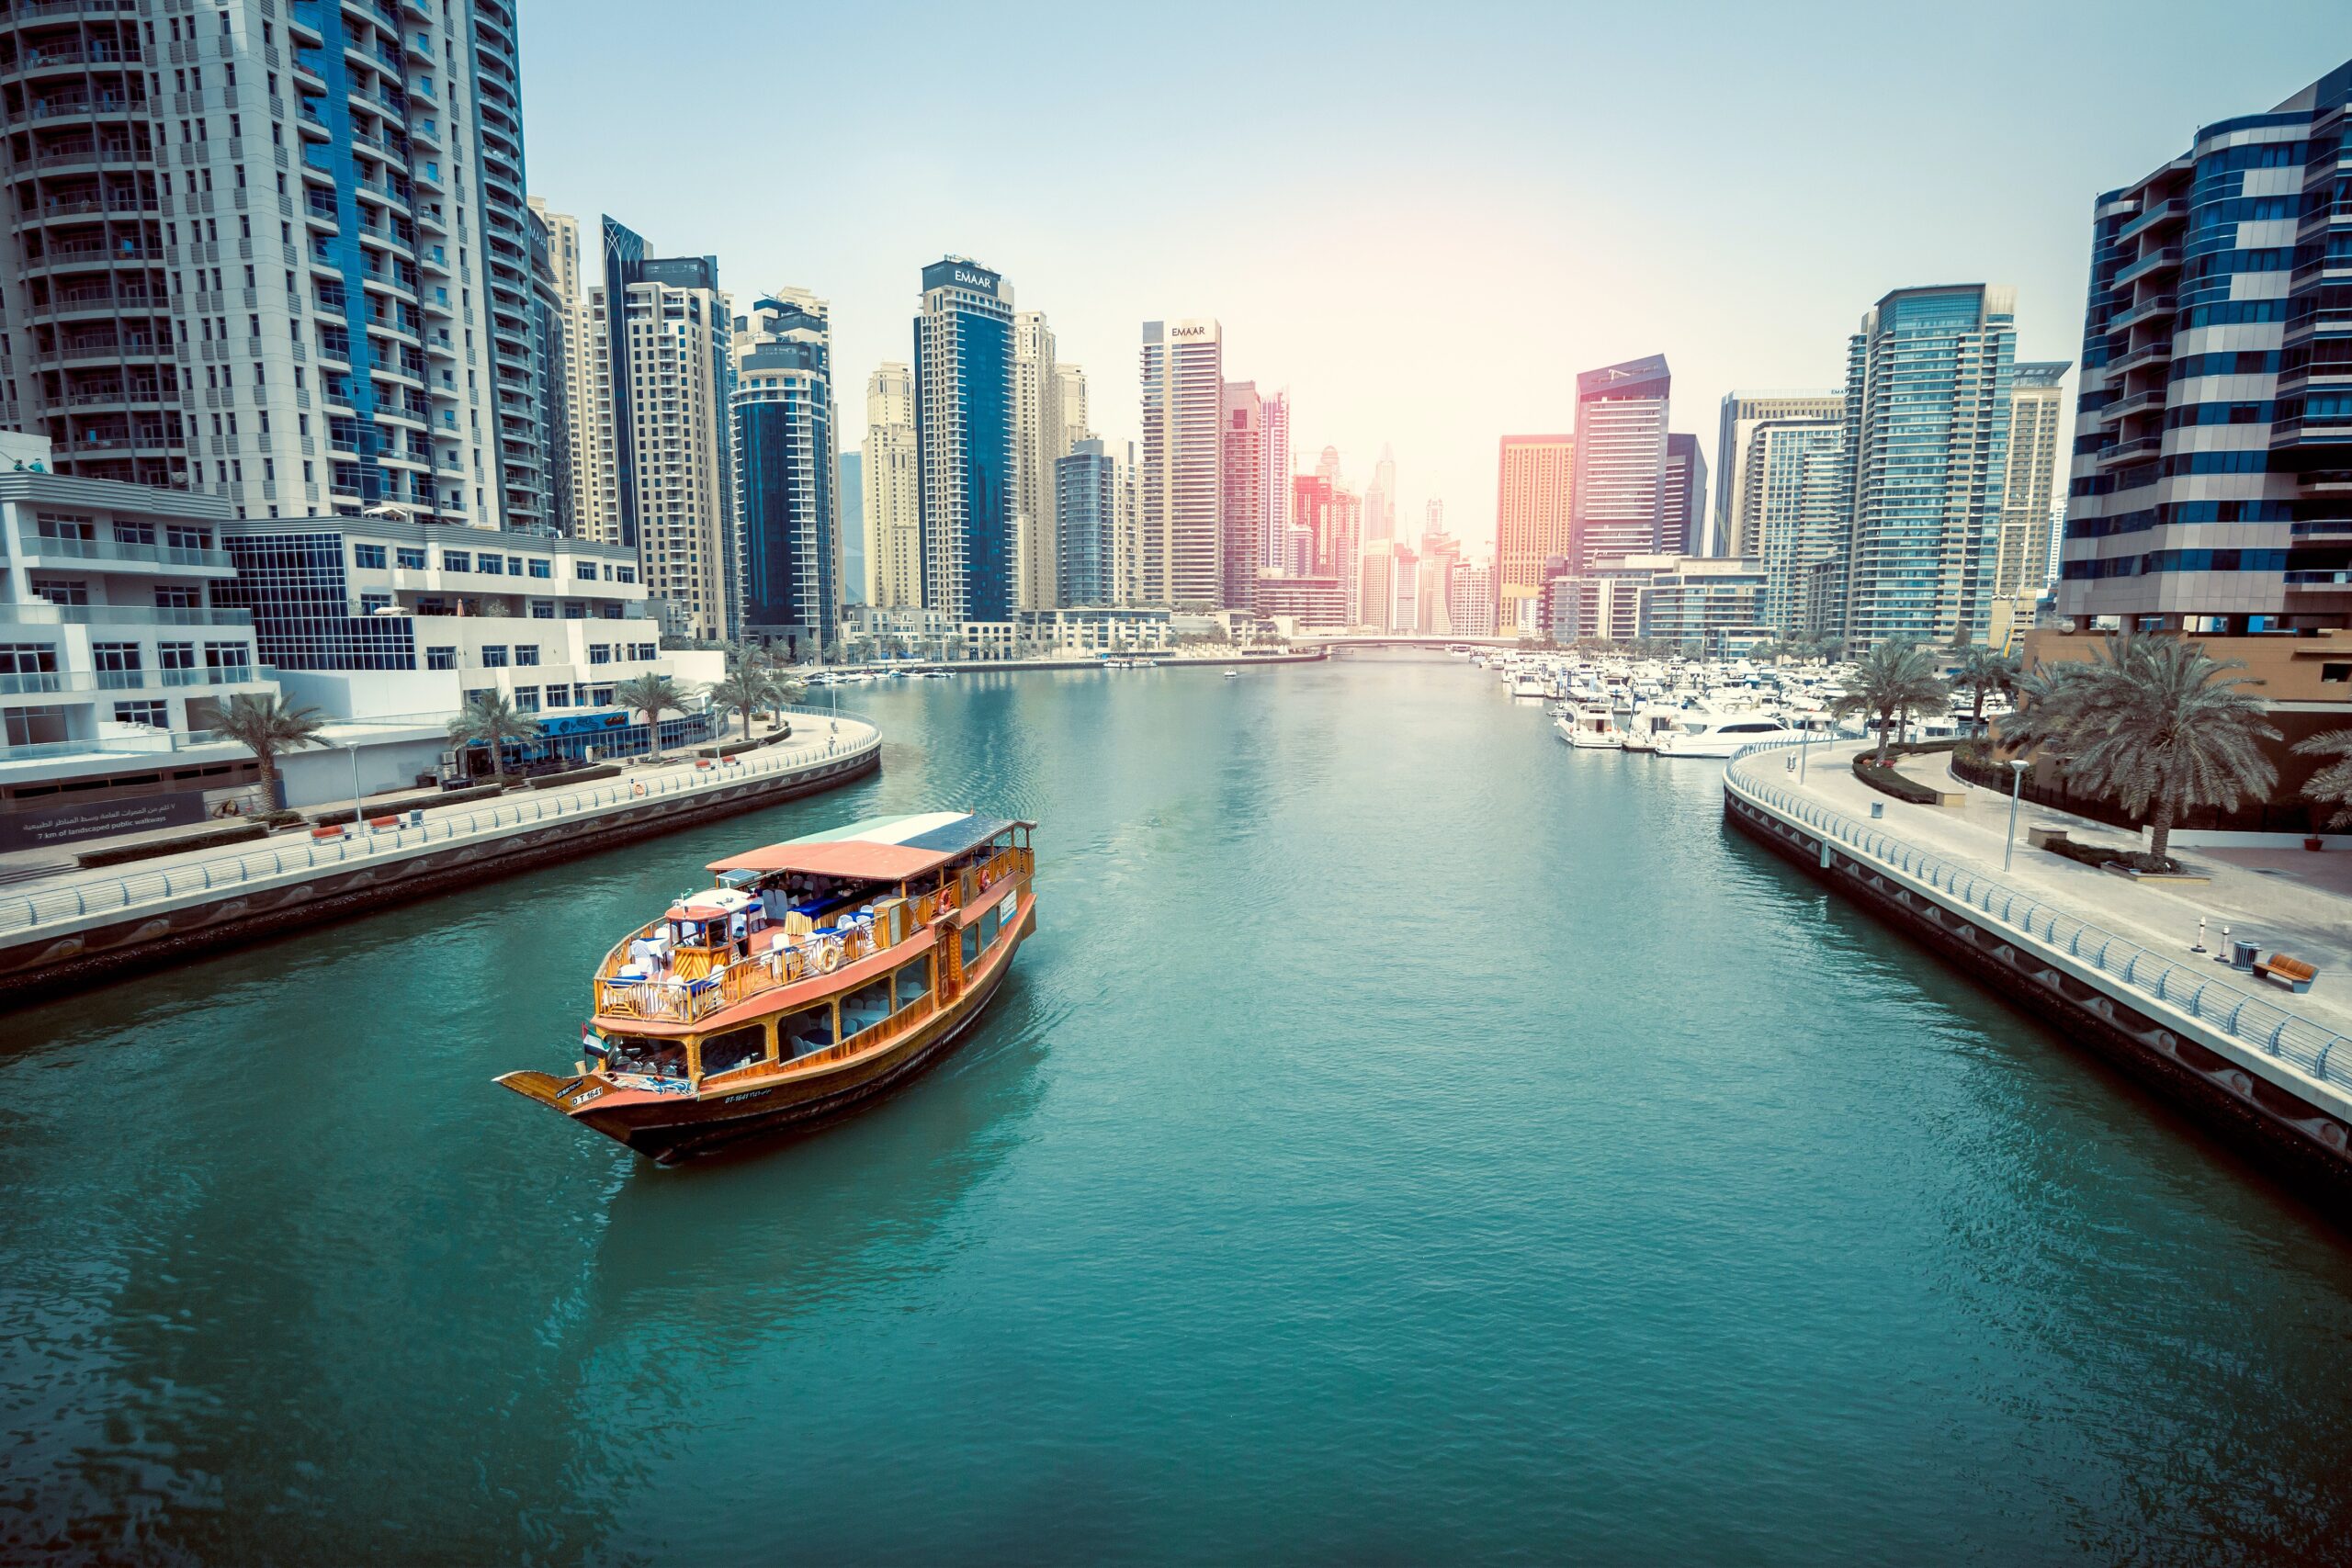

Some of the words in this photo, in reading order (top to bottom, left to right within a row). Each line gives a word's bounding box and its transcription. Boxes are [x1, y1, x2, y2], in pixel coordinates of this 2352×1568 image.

[955, 270, 991, 288] EMAAR
[1171, 326, 1205, 336] EMAAR
[121, 807, 147, 817] الممرات
[69, 824, 110, 835] landscaped
[111, 820, 133, 830] public
[134, 816, 167, 825] walkways
[587, 1088, 603, 1100] 1641
